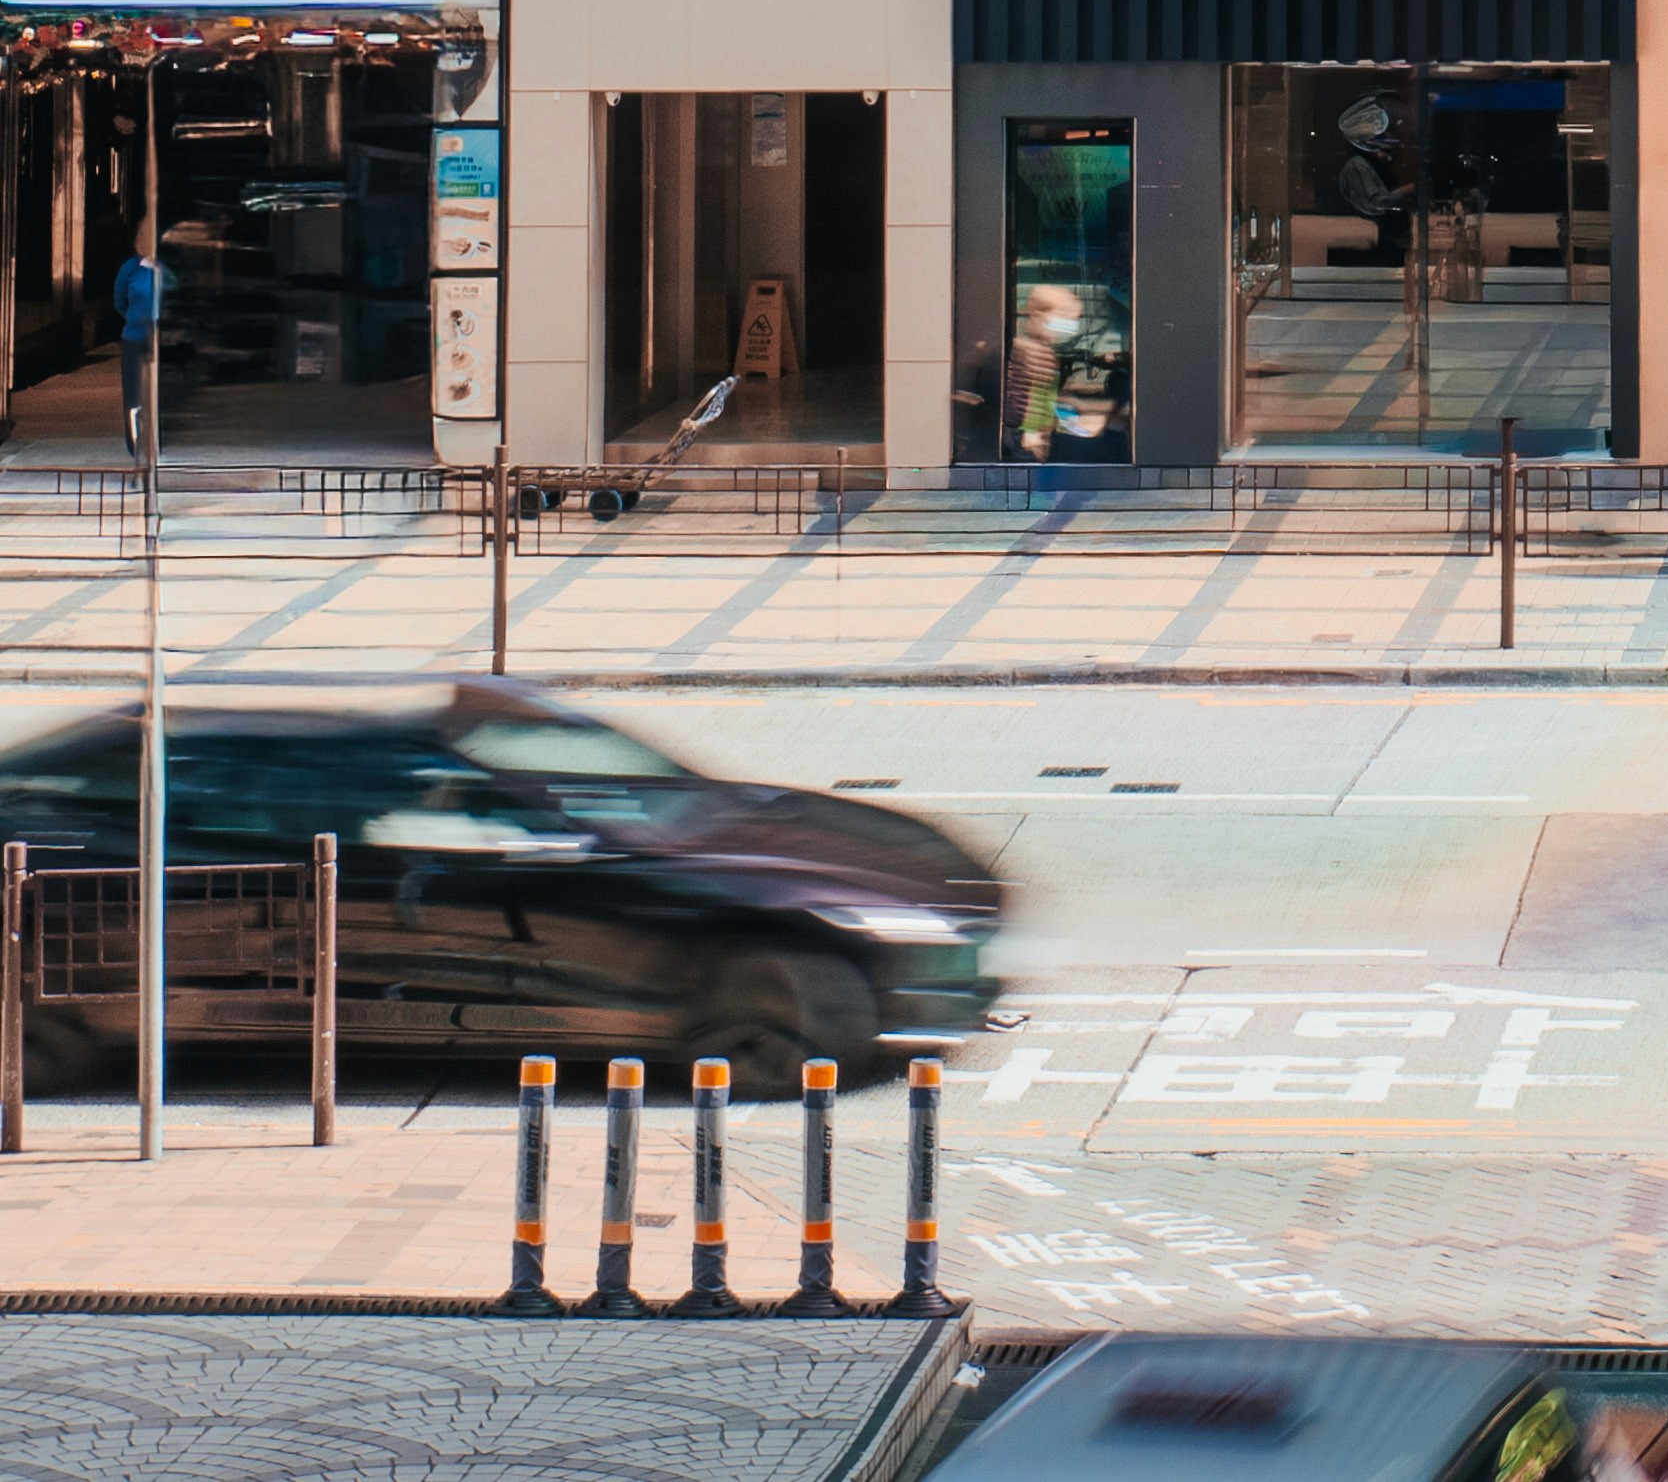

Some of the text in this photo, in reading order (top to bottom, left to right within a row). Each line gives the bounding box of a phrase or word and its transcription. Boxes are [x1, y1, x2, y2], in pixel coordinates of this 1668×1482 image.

[821, 1124, 834, 1204] HARBOUR CITY
[921, 1124, 935, 1203] HARBOUR CITY
